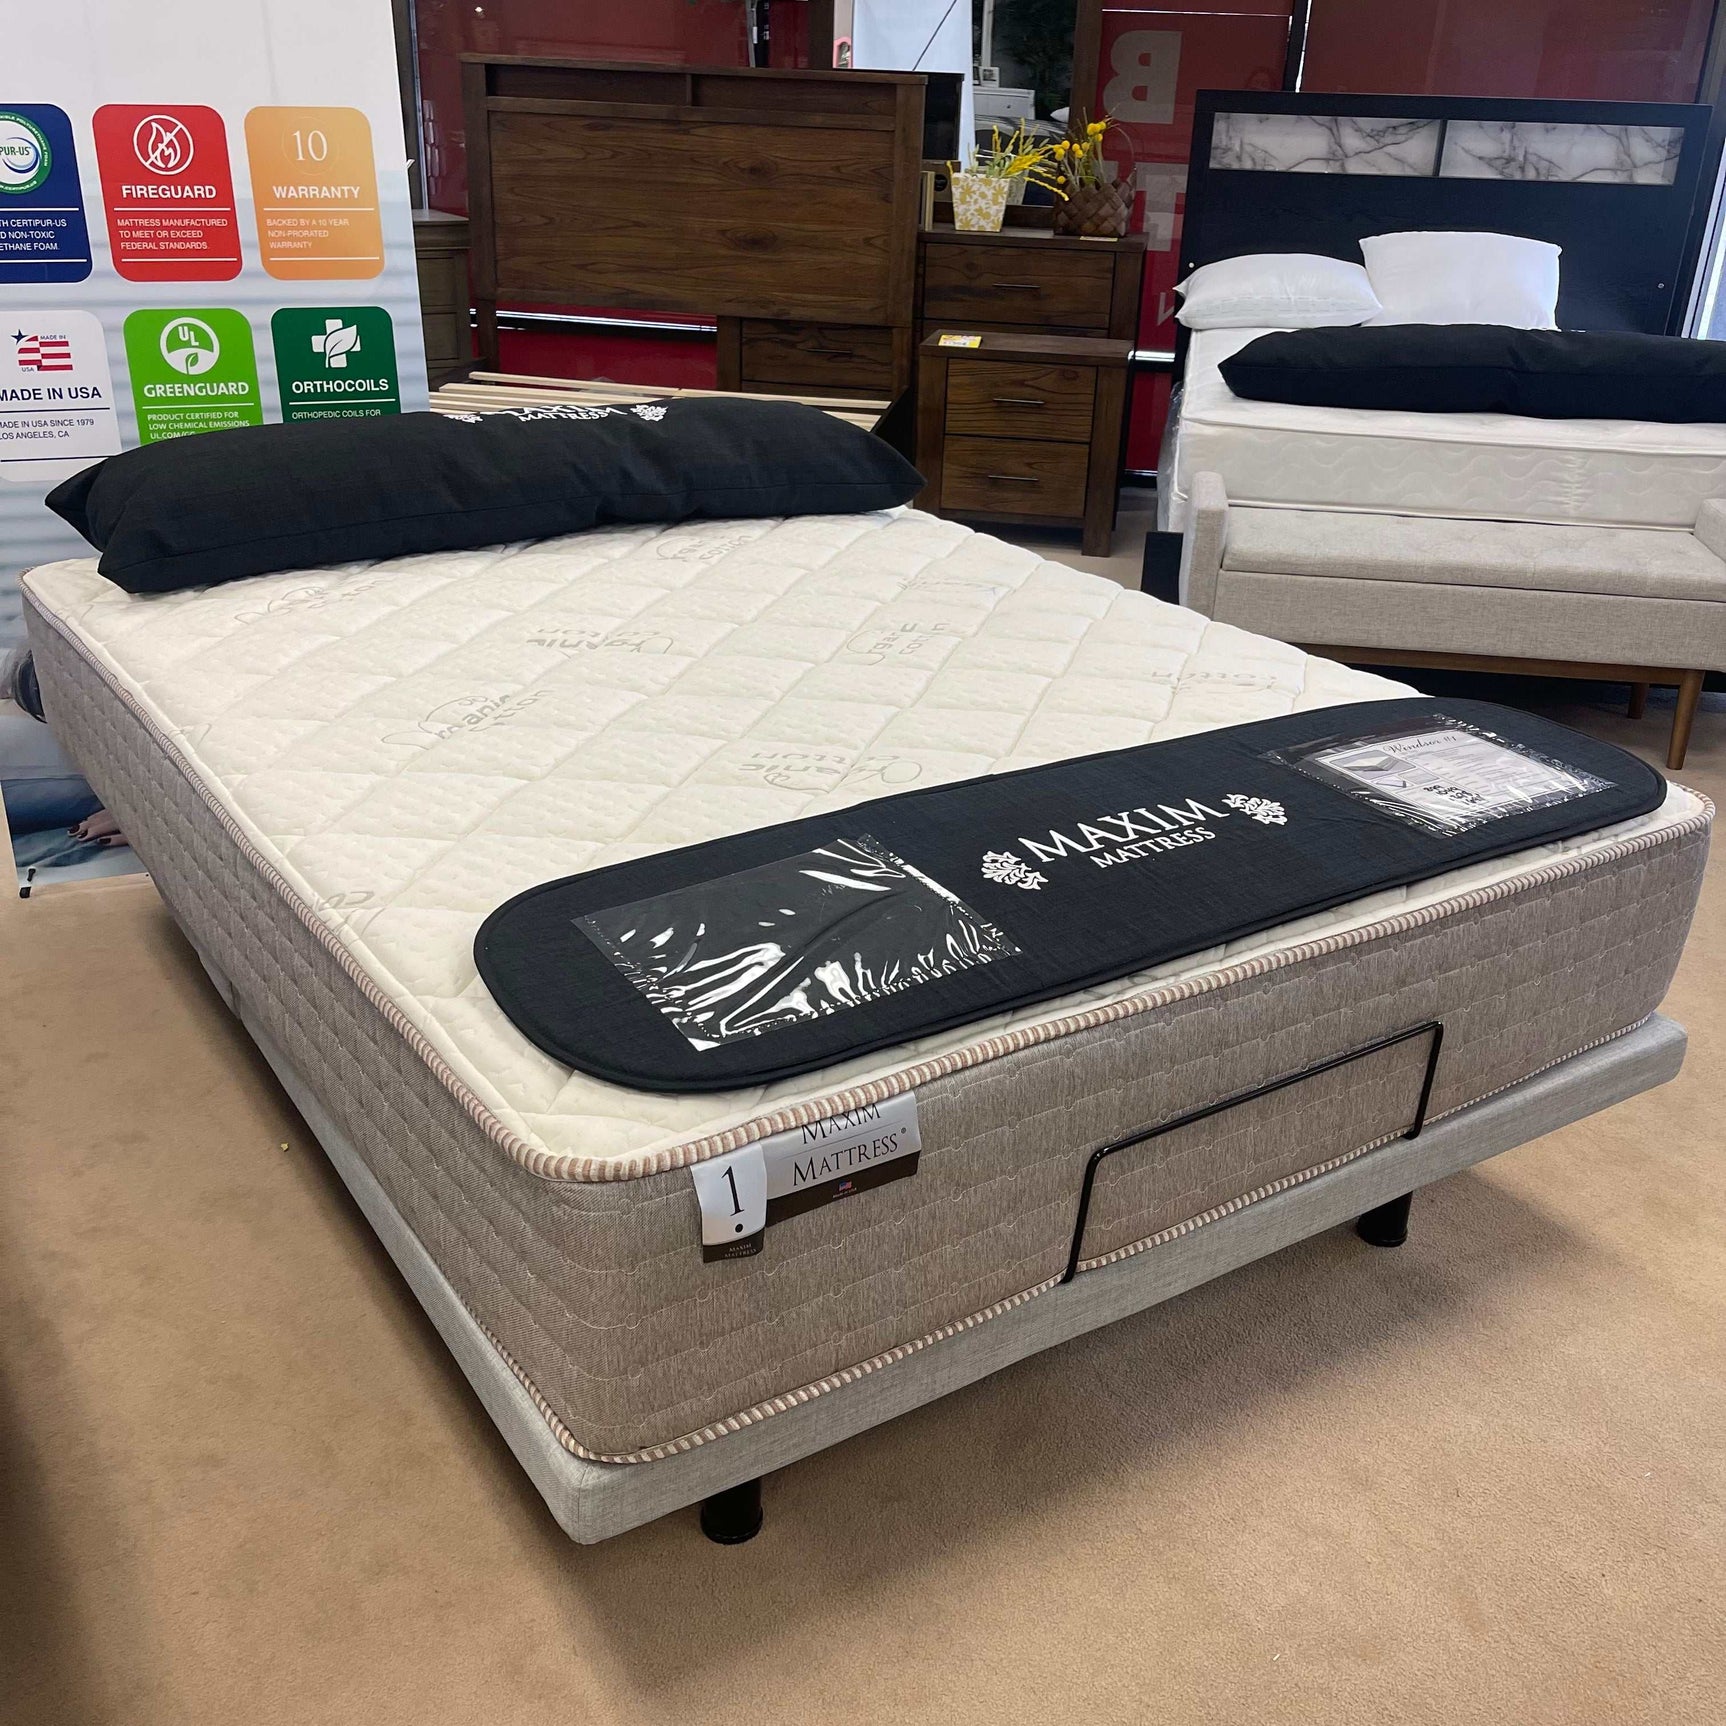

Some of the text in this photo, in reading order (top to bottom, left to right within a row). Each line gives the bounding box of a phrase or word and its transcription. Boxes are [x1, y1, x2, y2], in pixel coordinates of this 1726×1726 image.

[292, 130, 328, 161] 10
[121, 185, 217, 199] FIREGUARD
[272, 185, 360, 199] WARRANTY
[10, 218, 67, 228] CERTIPUR-US
[117, 218, 228, 227] MATTRESS MANUFACTURED
[266, 218, 350, 227] BACKED BY A 10 YEAR
[8, 230, 55, 239] NON-TOXIC
[119, 230, 203, 238] TO MEET OR EXCEED
[267, 229, 329, 238] NON-PRORATED
[120, 242, 158, 250] FEDERAL
[269, 241, 313, 249] WARRANTY
[178, 326, 200, 346] UL
[143, 382, 249, 398] GREENGUARD
[291, 378, 389, 394] ORTHOCOILS
[47, 387, 64, 400] IN
[68, 386, 102, 400] USA
[147, 413, 184, 421] PRODUCT
[185, 412, 222, 420] CERTIFIED
[291, 410, 341, 420] ORTHOPEDIC
[342, 409, 365, 418] COILS
[519, 411, 610, 422] MATTRESS
[21, 420, 30, 428] IN
[31, 419, 49, 428] USA
[50, 419, 75, 427] SINCE
[76, 418, 95, 426] 1979
[168, 422, 207, 430] CHEMICAL
[209, 420, 250, 428] EMISSIONS
[16, 430, 57, 439] ANGELES,
[57, 430, 70, 438] CA
[1383, 738, 1442, 753] Windsor
[1018, 798, 1231, 863] MAXIM
[1090, 826, 1216, 869] MATTRESS
[801, 1103, 881, 1145] MAXIM
[793, 1133, 898, 1187] MATTRESS
[720, 1165, 745, 1217] 1
